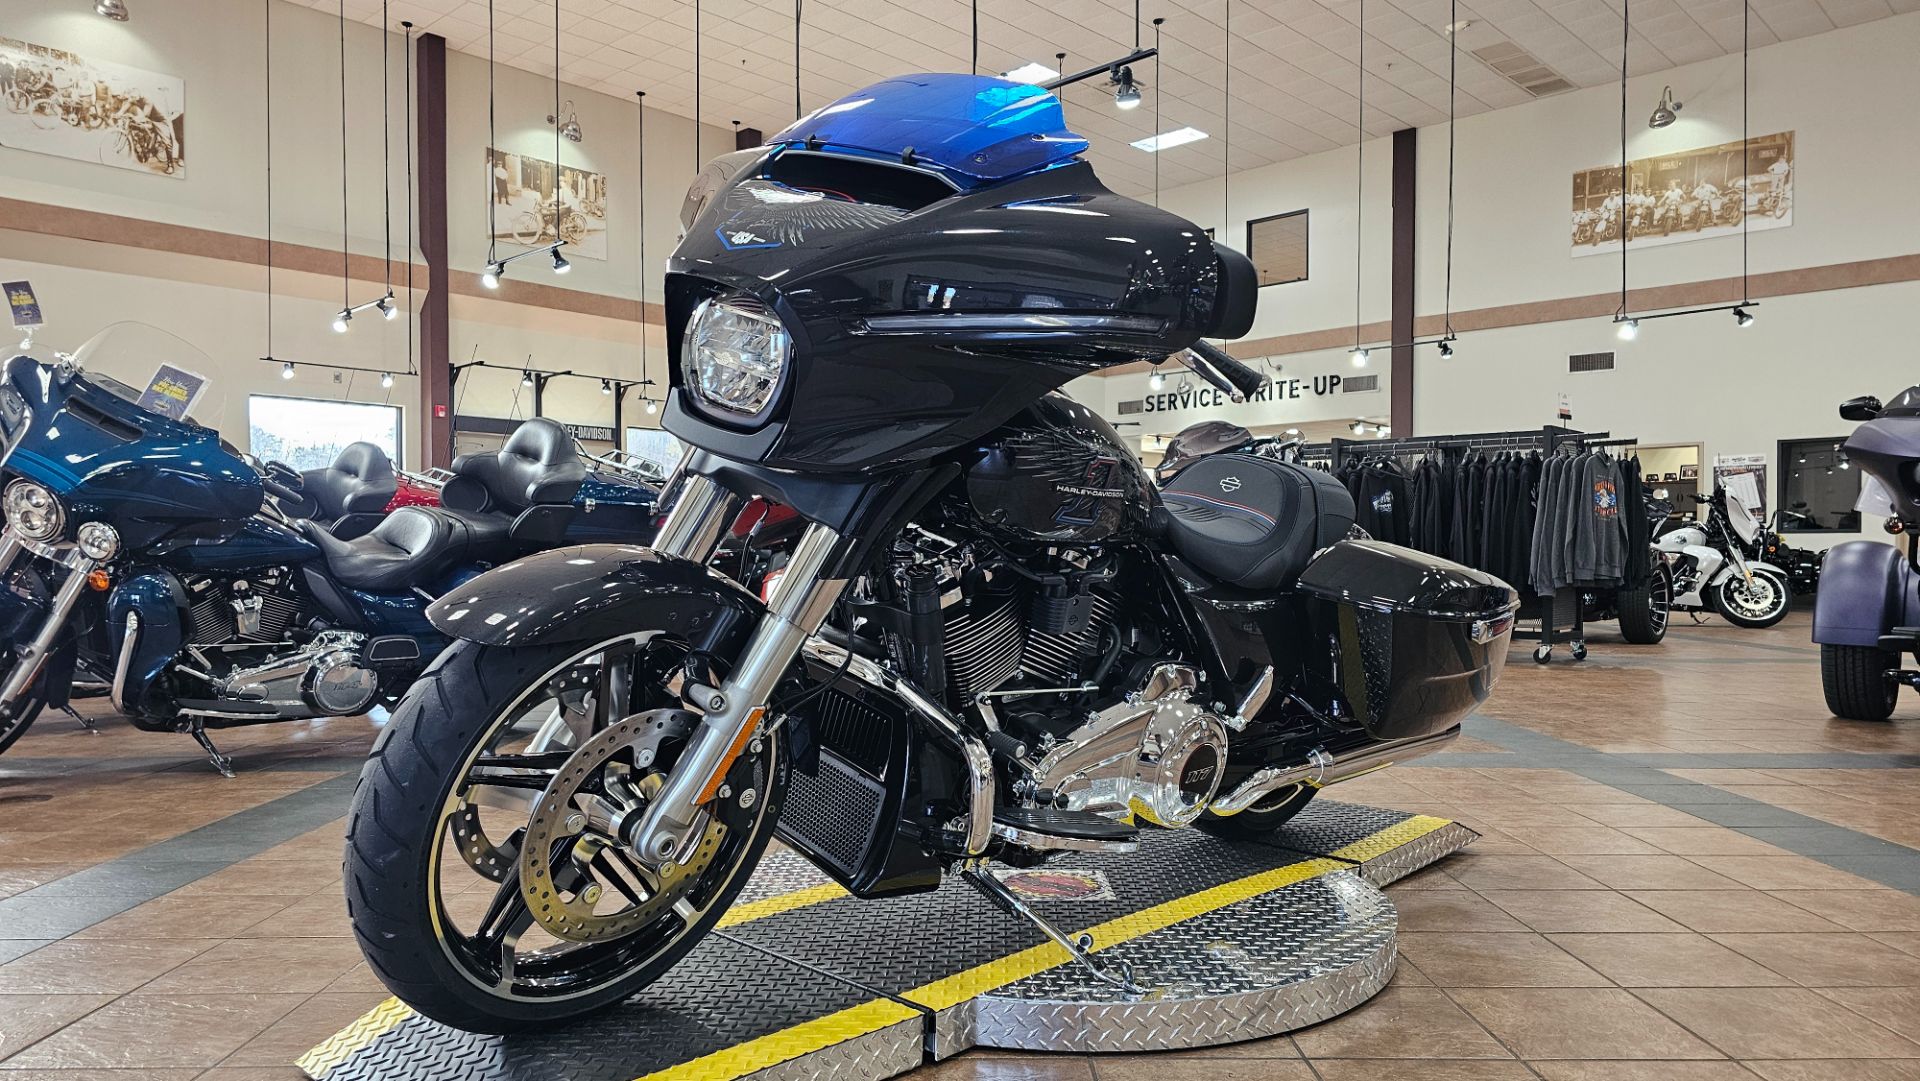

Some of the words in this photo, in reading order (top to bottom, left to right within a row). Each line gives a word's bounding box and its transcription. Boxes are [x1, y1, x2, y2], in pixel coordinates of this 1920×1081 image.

[731, 231, 755, 244] USA
[1145, 388, 1223, 412] SERVICE
[1245, 375, 1341, 402] RITE-UP
[1056, 484, 1124, 498] HARLEY-DAVIDSON
[1185, 765, 1214, 784] 117
